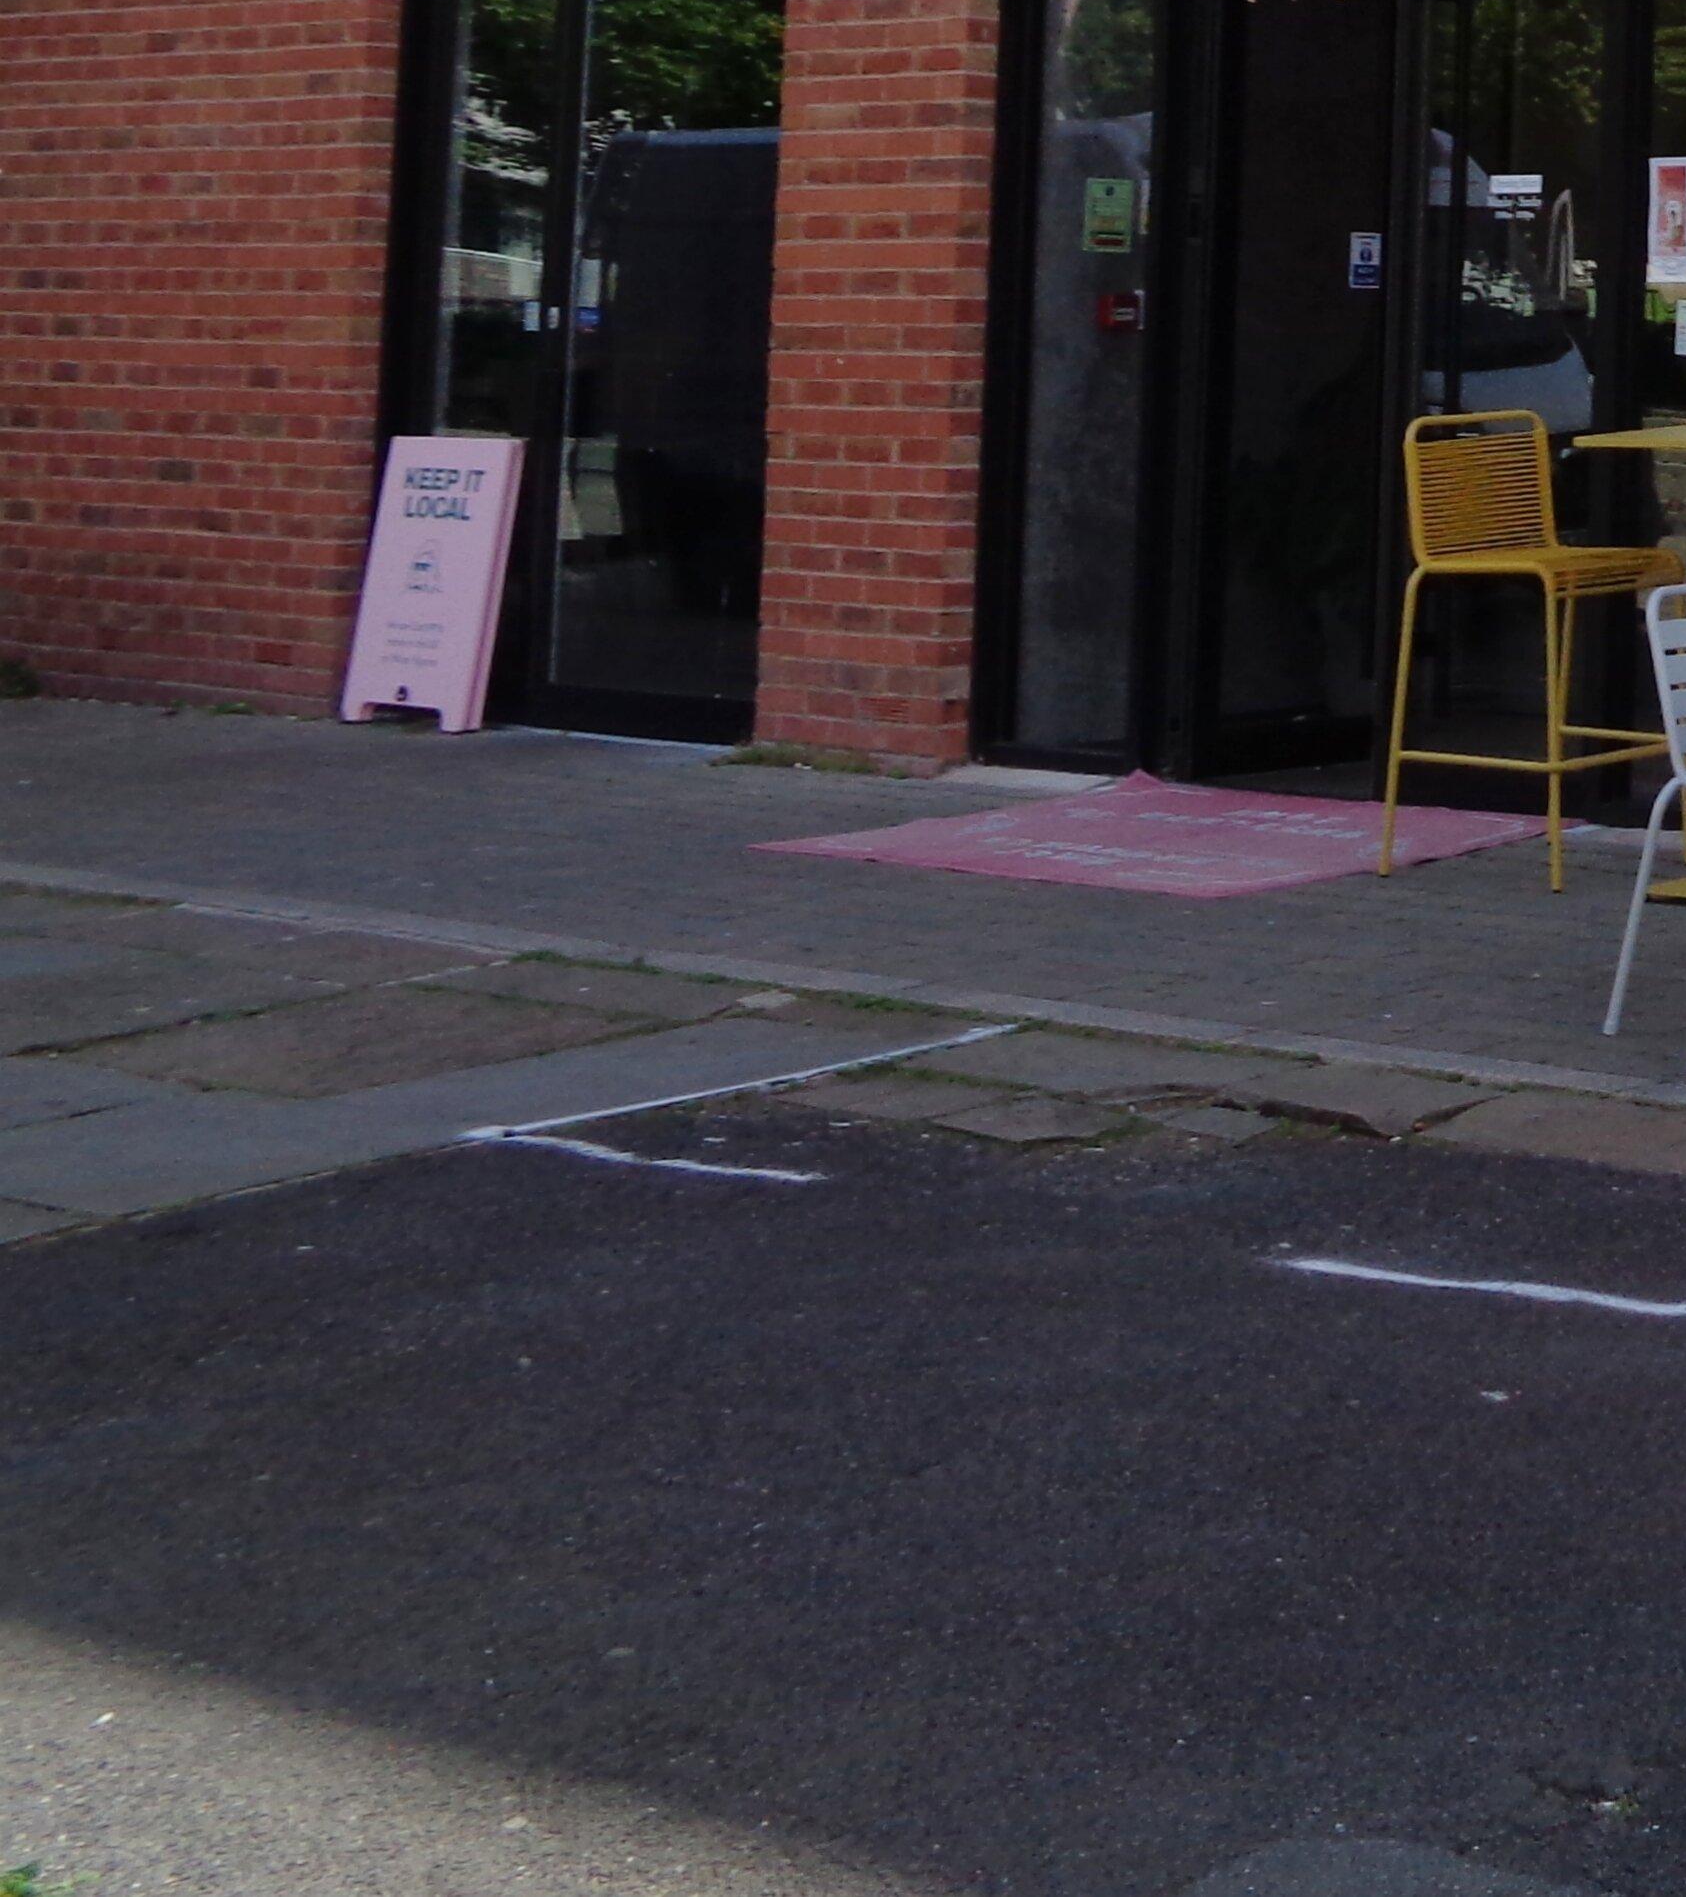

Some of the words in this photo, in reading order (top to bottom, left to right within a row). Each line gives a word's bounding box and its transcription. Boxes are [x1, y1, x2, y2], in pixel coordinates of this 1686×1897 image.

[404, 467, 461, 491] KEEP
[464, 469, 487, 492] IT
[404, 495, 471, 521] LOCAL
